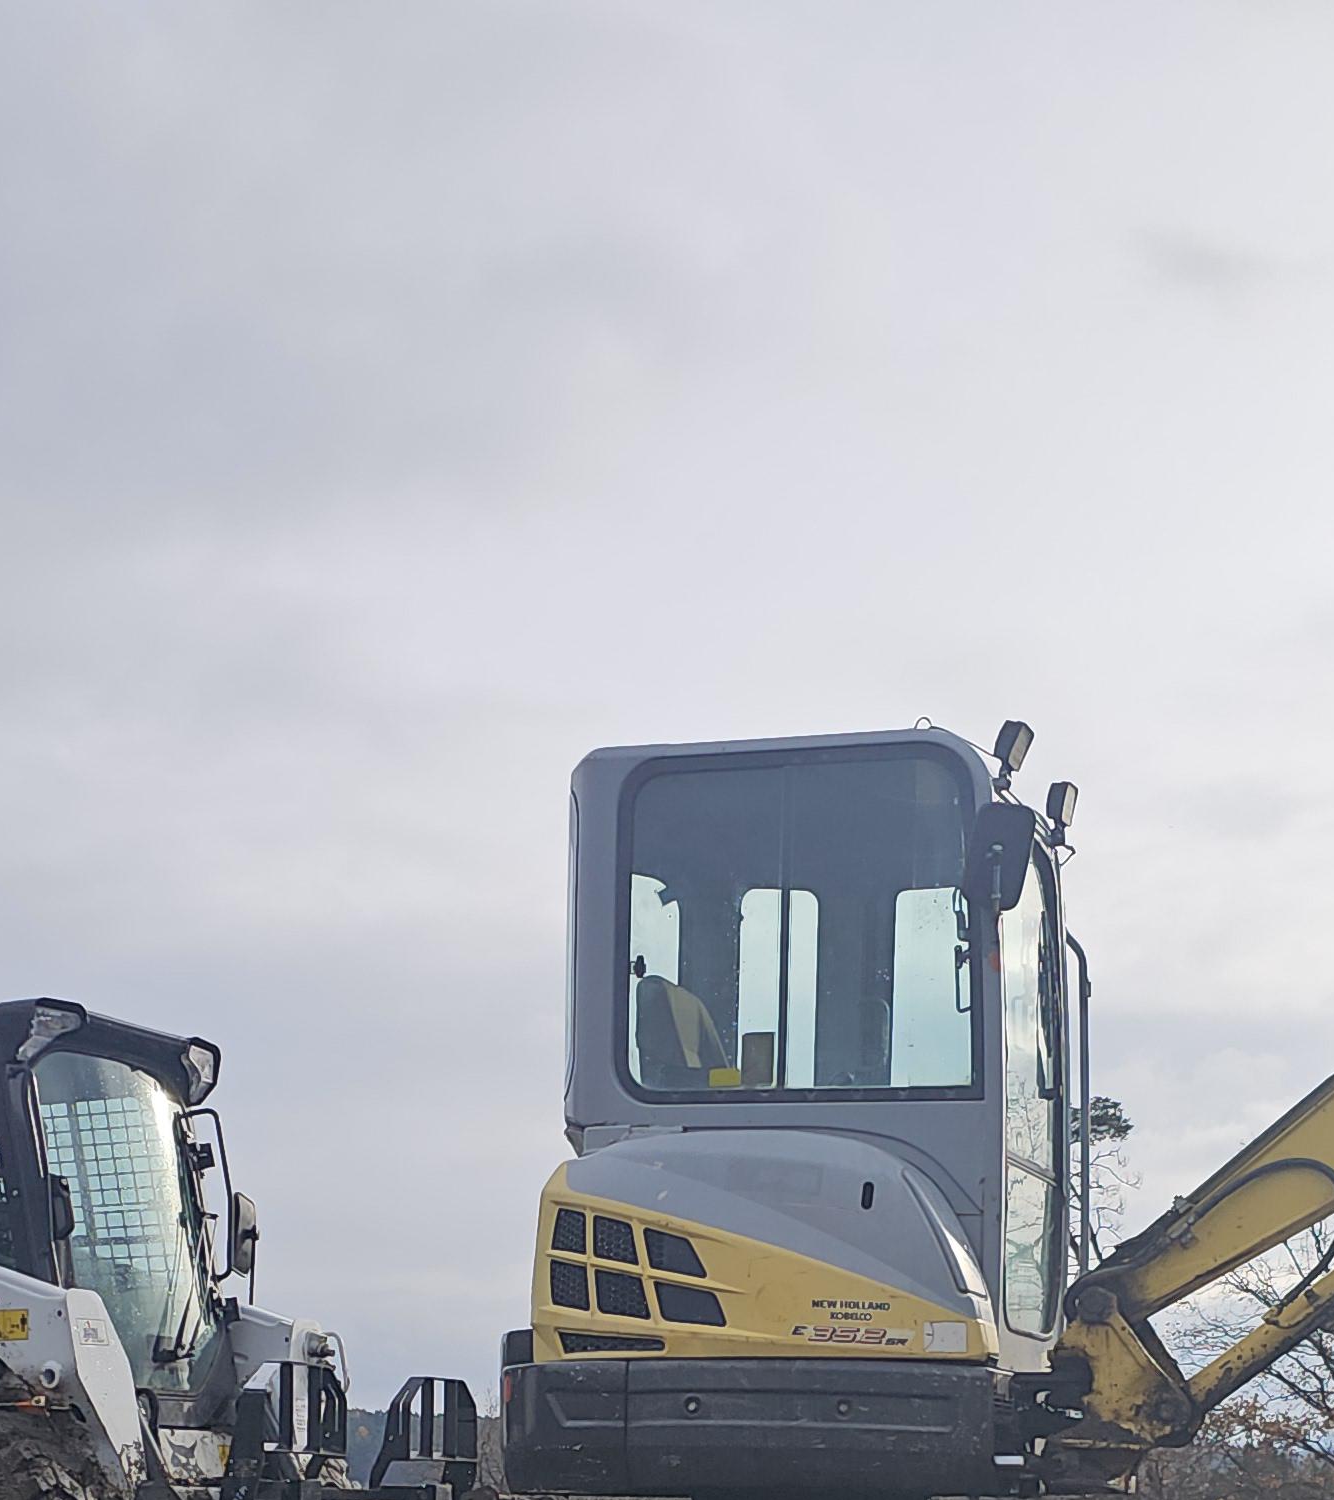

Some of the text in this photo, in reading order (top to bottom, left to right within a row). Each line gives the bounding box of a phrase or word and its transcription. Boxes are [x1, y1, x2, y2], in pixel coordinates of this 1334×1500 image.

[811, 1299, 891, 1311] NEW HOLLAND
[829, 1311, 873, 1322] KOBELCO
